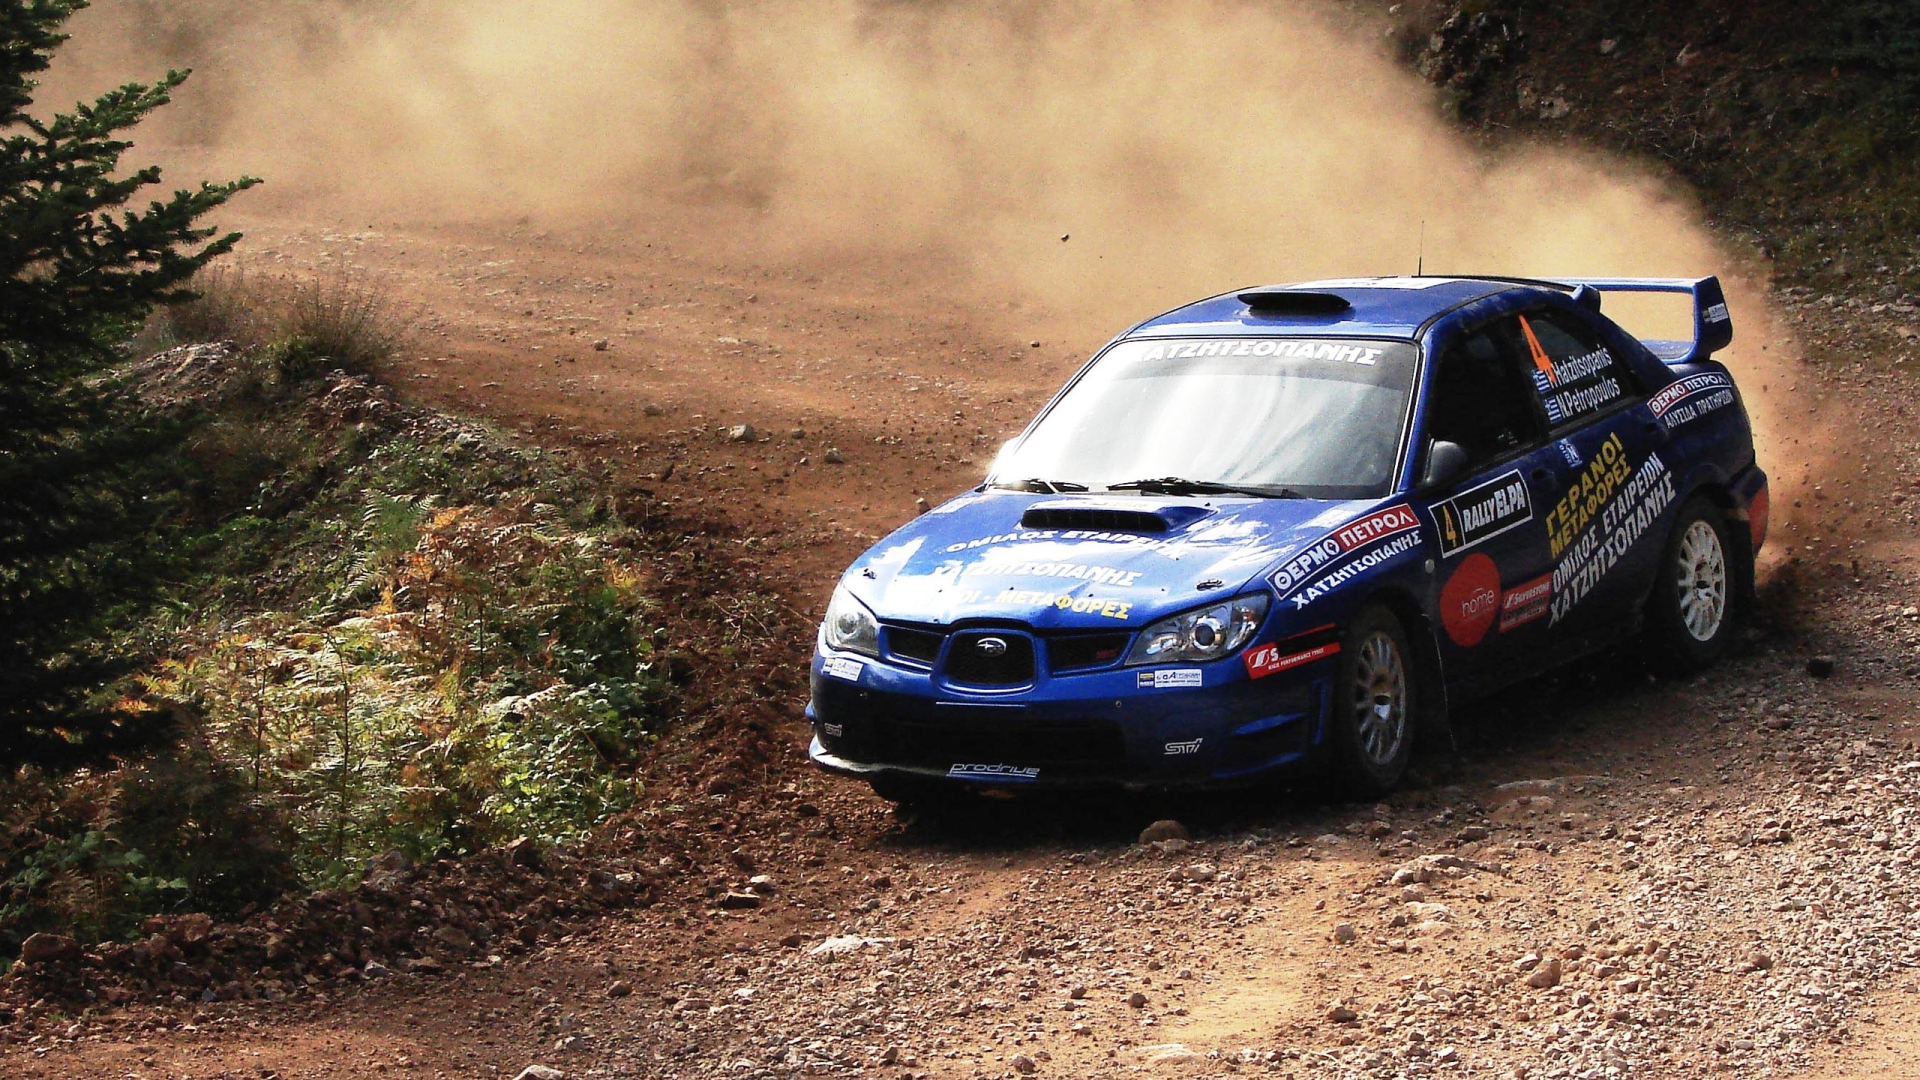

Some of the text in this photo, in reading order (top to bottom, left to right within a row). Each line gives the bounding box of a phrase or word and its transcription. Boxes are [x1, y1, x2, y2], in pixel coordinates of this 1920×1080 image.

[1518, 314, 1557, 383] 4
[1546, 432, 1624, 537] ΓΕΡΑΝΟΙ
[1550, 453, 1632, 559] ΜΕΤΑΦΟΡΕΣ
[946, 530, 1057, 553] ΟΜΙΛΟΣ
[1442, 505, 1457, 548] 4
[1548, 470, 1677, 629] ΧΑΤΖΗΤΣΟΠΑΝΗΣ
[1552, 524, 1600, 593] ΟΜΙΛΟΣ
[1602, 451, 1666, 535] ΕΤΑΙΡΕΙΩΝ
[1291, 530, 1423, 610] ΧΑΤΖΗΤΣΟΠΑΝΗΣ
[1461, 589, 1495, 617] home
[997, 590, 1134, 620] ΜΕΤΑΦΟΡΕΣ
[949, 762, 1041, 775] prodrive
